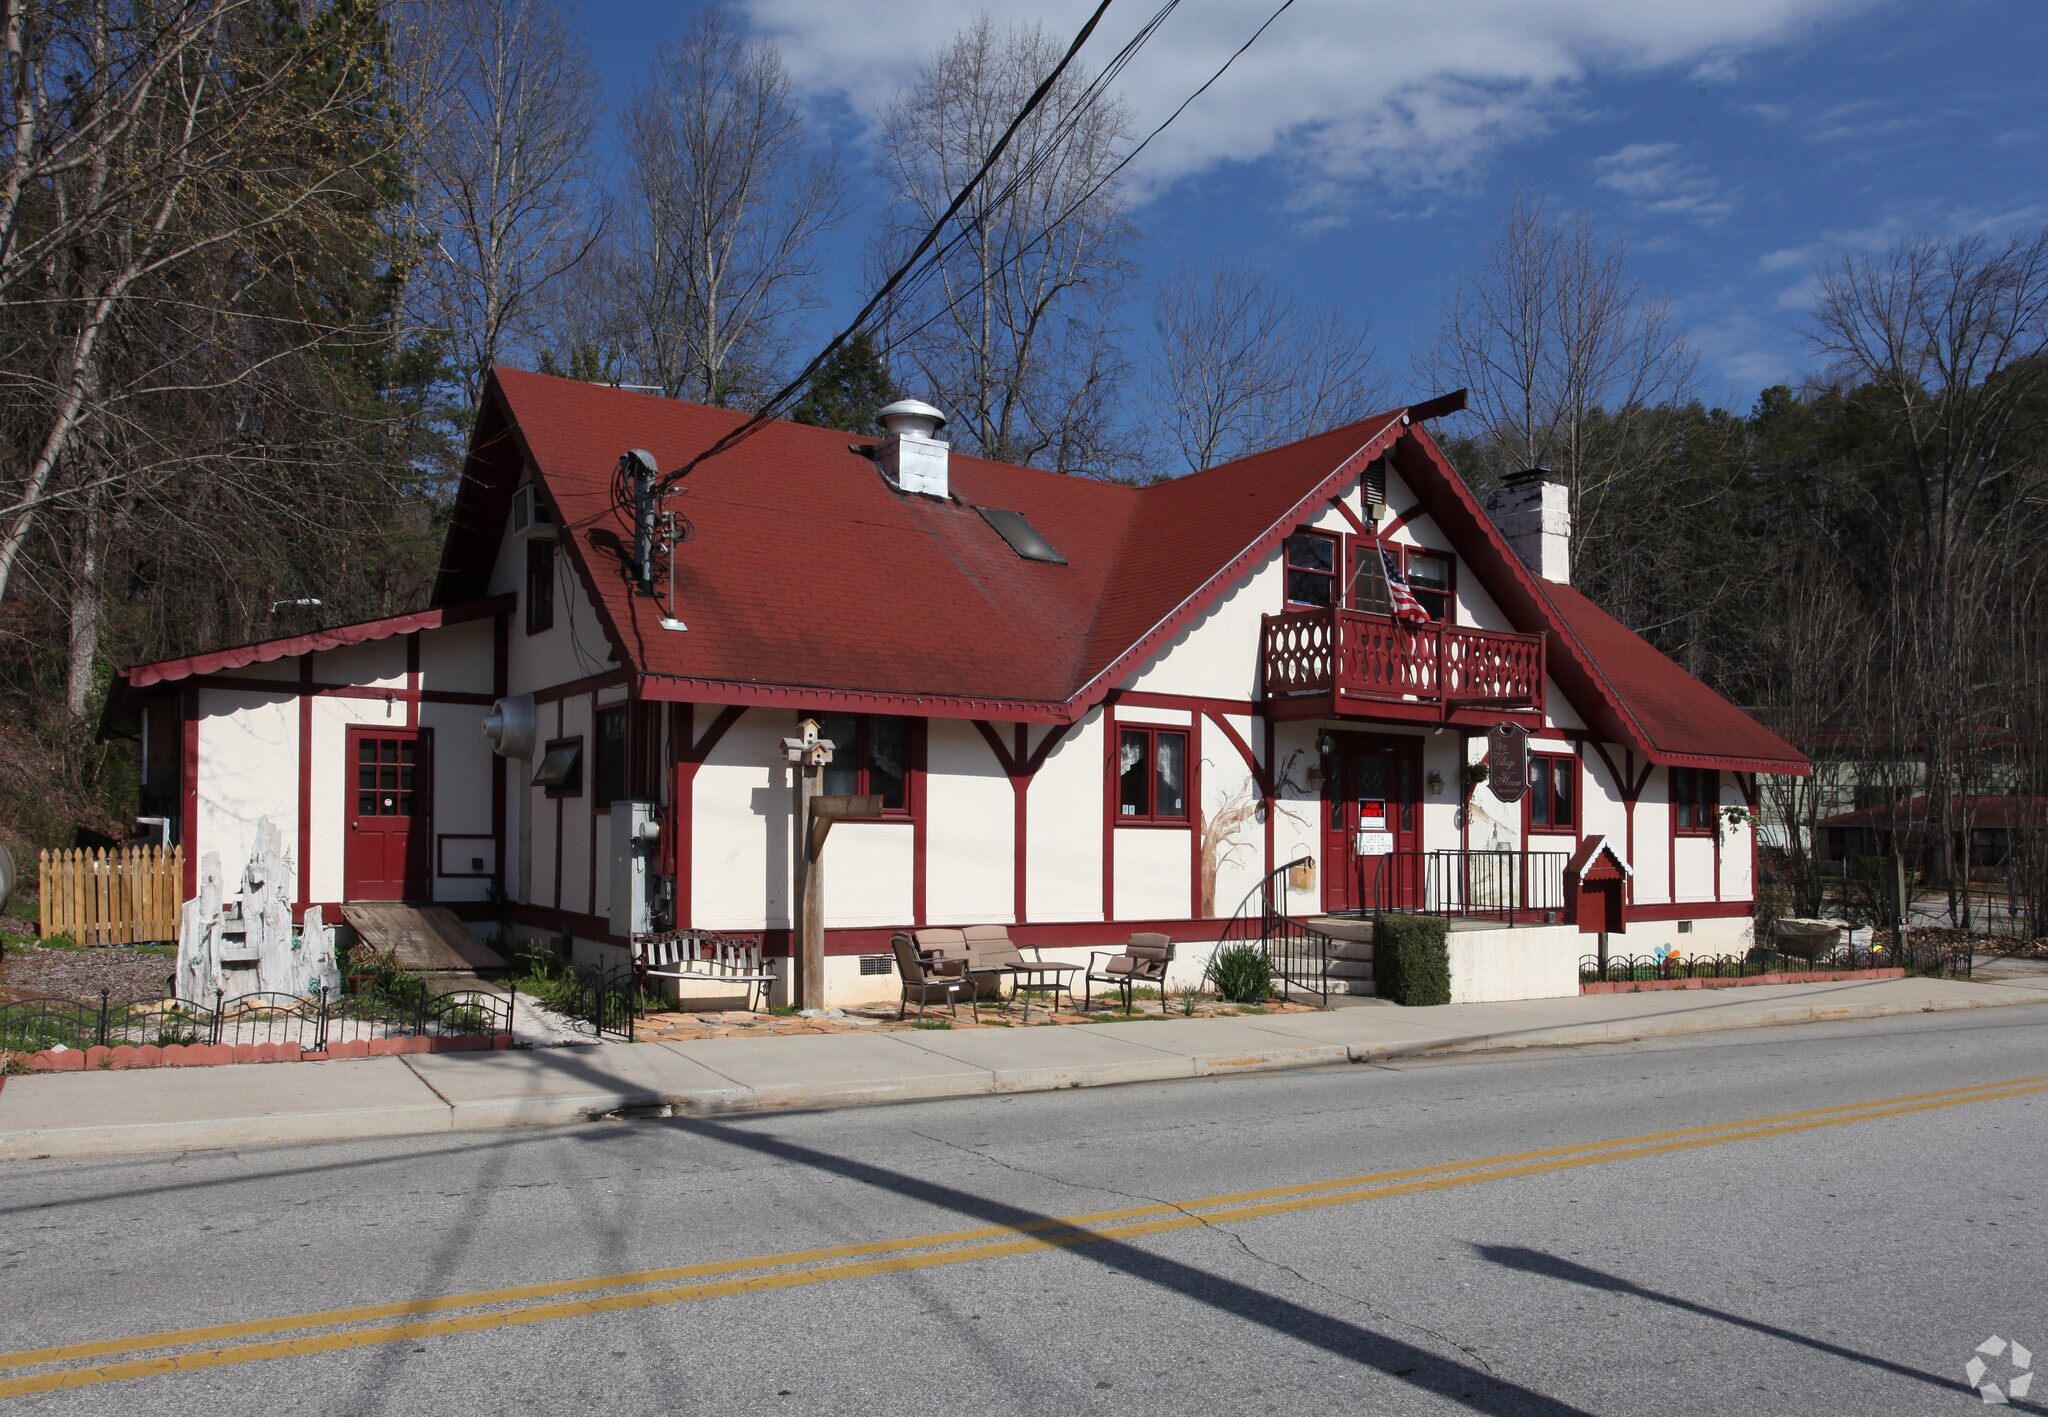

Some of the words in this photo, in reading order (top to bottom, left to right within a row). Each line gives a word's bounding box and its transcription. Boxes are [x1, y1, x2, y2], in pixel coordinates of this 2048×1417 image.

[1493, 752, 1516, 770] Village
[1494, 771, 1522, 787] House
[1365, 801, 1380, 809] FOR
[1361, 809, 1384, 817] RENT
[1365, 835, 1385, 844] WATCH
[1362, 845, 1375, 854] OUR
[1377, 845, 1392, 854] STEP
